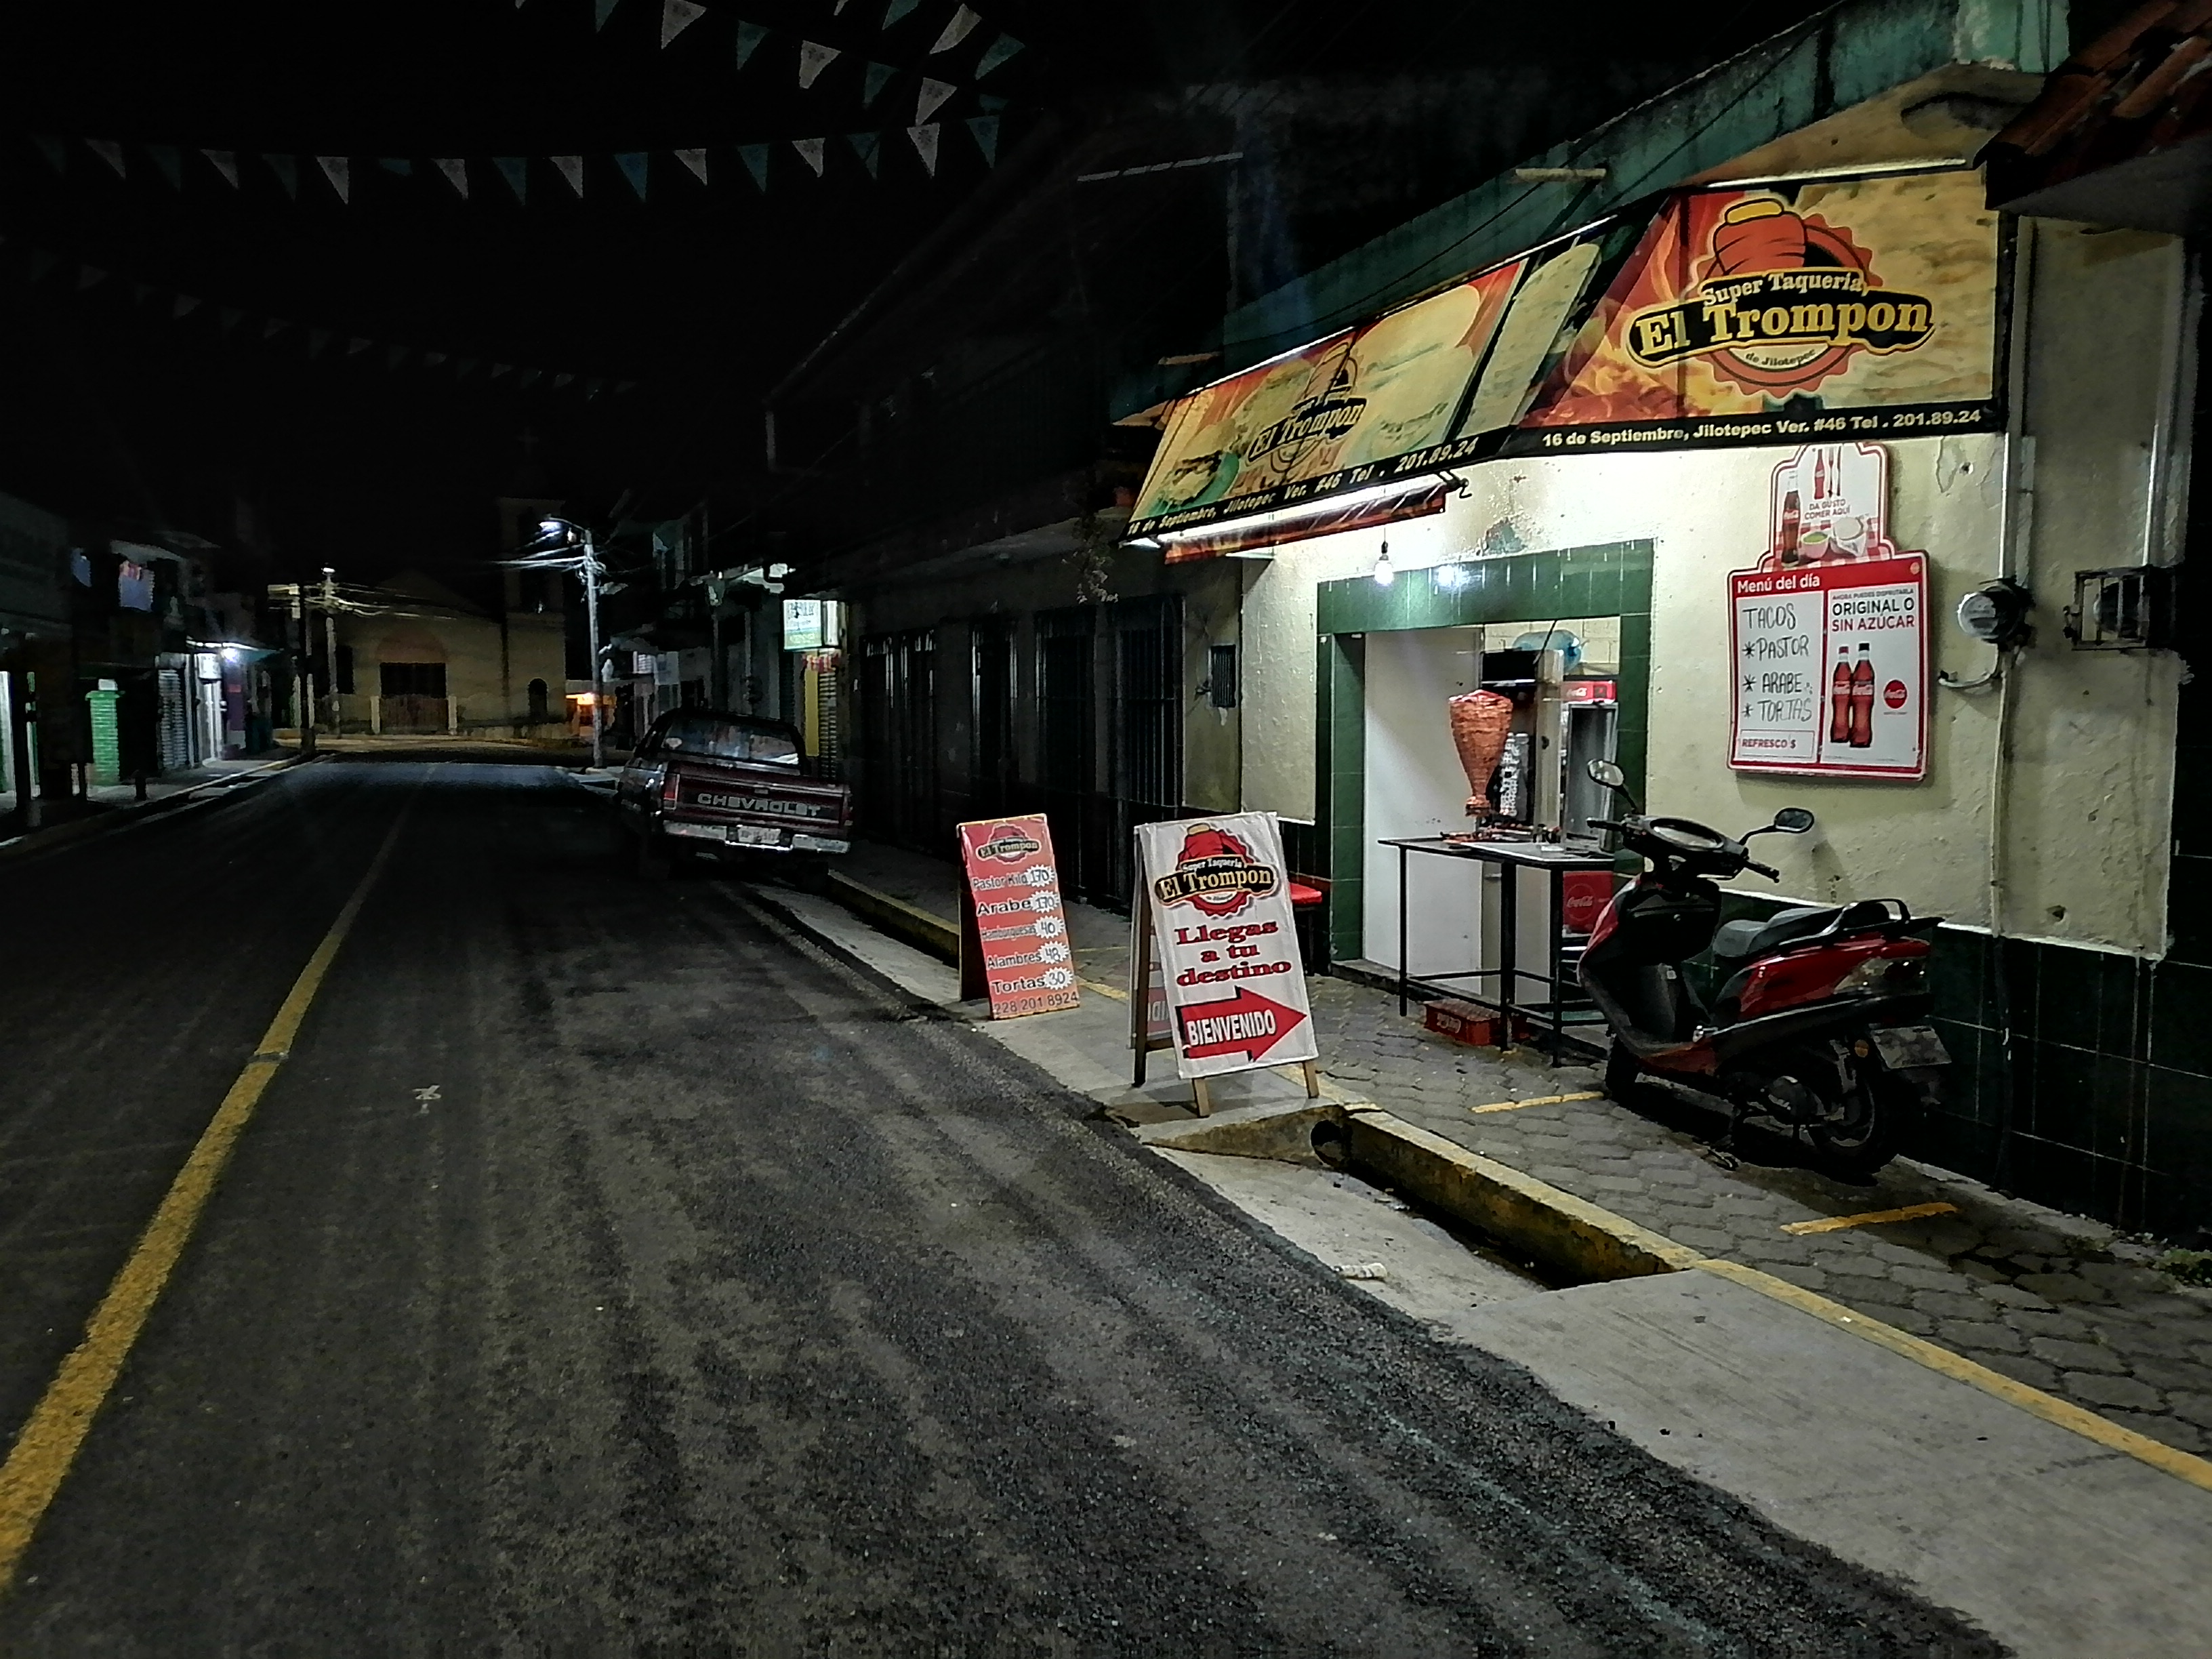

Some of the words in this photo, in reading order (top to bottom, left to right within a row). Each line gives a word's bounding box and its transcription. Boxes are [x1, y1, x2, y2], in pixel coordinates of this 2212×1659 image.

[1703, 278, 1761, 307] Super
[1635, 310, 1691, 356] El
[1703, 300, 1930, 346] Trompon
[1745, 352, 1759, 364] de
[1761, 348, 1817, 367] Jilotepec
[1248, 426, 1279, 459] El
[1277, 403, 1365, 445] Trompon
[1542, 432, 1562, 447] 16
[1566, 432, 1586, 446] de
[1591, 427, 1689, 446] Septiembre,
[1693, 417, 1771, 438] Jilotepec
[1776, 419, 1809, 434] Ver.
[1814, 417, 1846, 431] #46
[1893, 409, 1982, 428] 201.89.24
[1159, 506, 1216, 529] Septiembre,
[1223, 492, 1277, 514] Jilotepec
[1284, 482, 1306, 500] Ver.
[1315, 472, 1343, 494] #46
[1394, 437, 1479, 473] 201.89.24
[1804, 510, 1830, 520] COMER
[1809, 502, 1820, 510] DA
[1822, 498, 1847, 509] GUSTO
[1737, 577, 1773, 594] Menú
[1776, 574, 1797, 590] del
[1799, 573, 1820, 588] día
[1742, 602, 1797, 630] TACOS
[1832, 598, 1900, 616] ORIGINAL
[1903, 597, 1915, 611] O
[1832, 618, 1853, 632] SIN
[1857, 613, 1915, 631] AZÚCAR
[1741, 738, 1788, 748] REFRESCO
[697, 793, 821, 817] CHEVROLET
[980, 847, 991, 858] El
[992, 842, 1038, 854] Trompon
[973, 876, 1005, 890] Pastor
[1008, 874, 1027, 885] Kilo
[1030, 869, 1049, 883] 170
[1158, 876, 1183, 901] El
[1184, 869, 1272, 893] Trompon
[977, 899, 1032, 915] Arabe
[1036, 897, 1055, 910] 170
[1041, 921, 1056, 935] 40
[1174, 921, 1279, 945] Llegas
[987, 954, 1042, 969] Alambres
[1044, 947, 1061, 962] 48
[1200, 949, 1221, 963] a
[1226, 944, 1261, 960] tu
[991, 978, 1045, 994] Tortas
[1048, 971, 1066, 986] 30
[1176, 961, 1292, 987] destino
[994, 1000, 1018, 1015] 228
[1021, 997, 1044, 1010] 201
[1047, 991, 1078, 1006] 8924
[1186, 1008, 1277, 1046] BIENVENIDO
